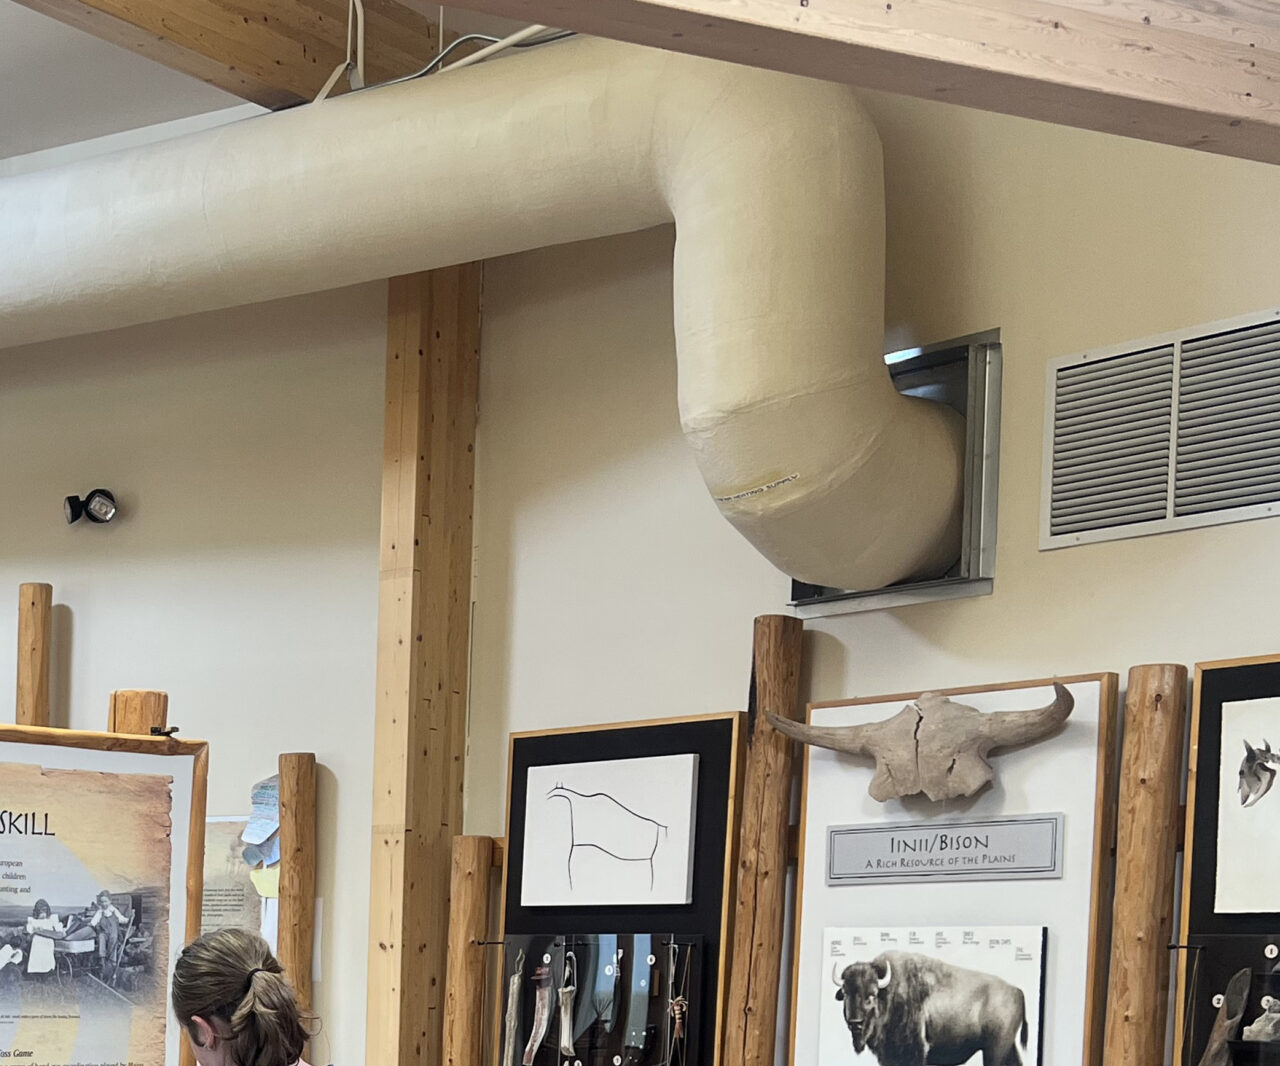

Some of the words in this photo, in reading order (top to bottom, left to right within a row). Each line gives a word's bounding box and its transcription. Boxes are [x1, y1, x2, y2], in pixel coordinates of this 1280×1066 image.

[865, 860, 873, 869] A
[876, 859, 897, 868] RICH
[900, 858, 944, 868] RESOURCE
[962, 856, 978, 864] THE
[982, 854, 1015, 864] PLAINS
